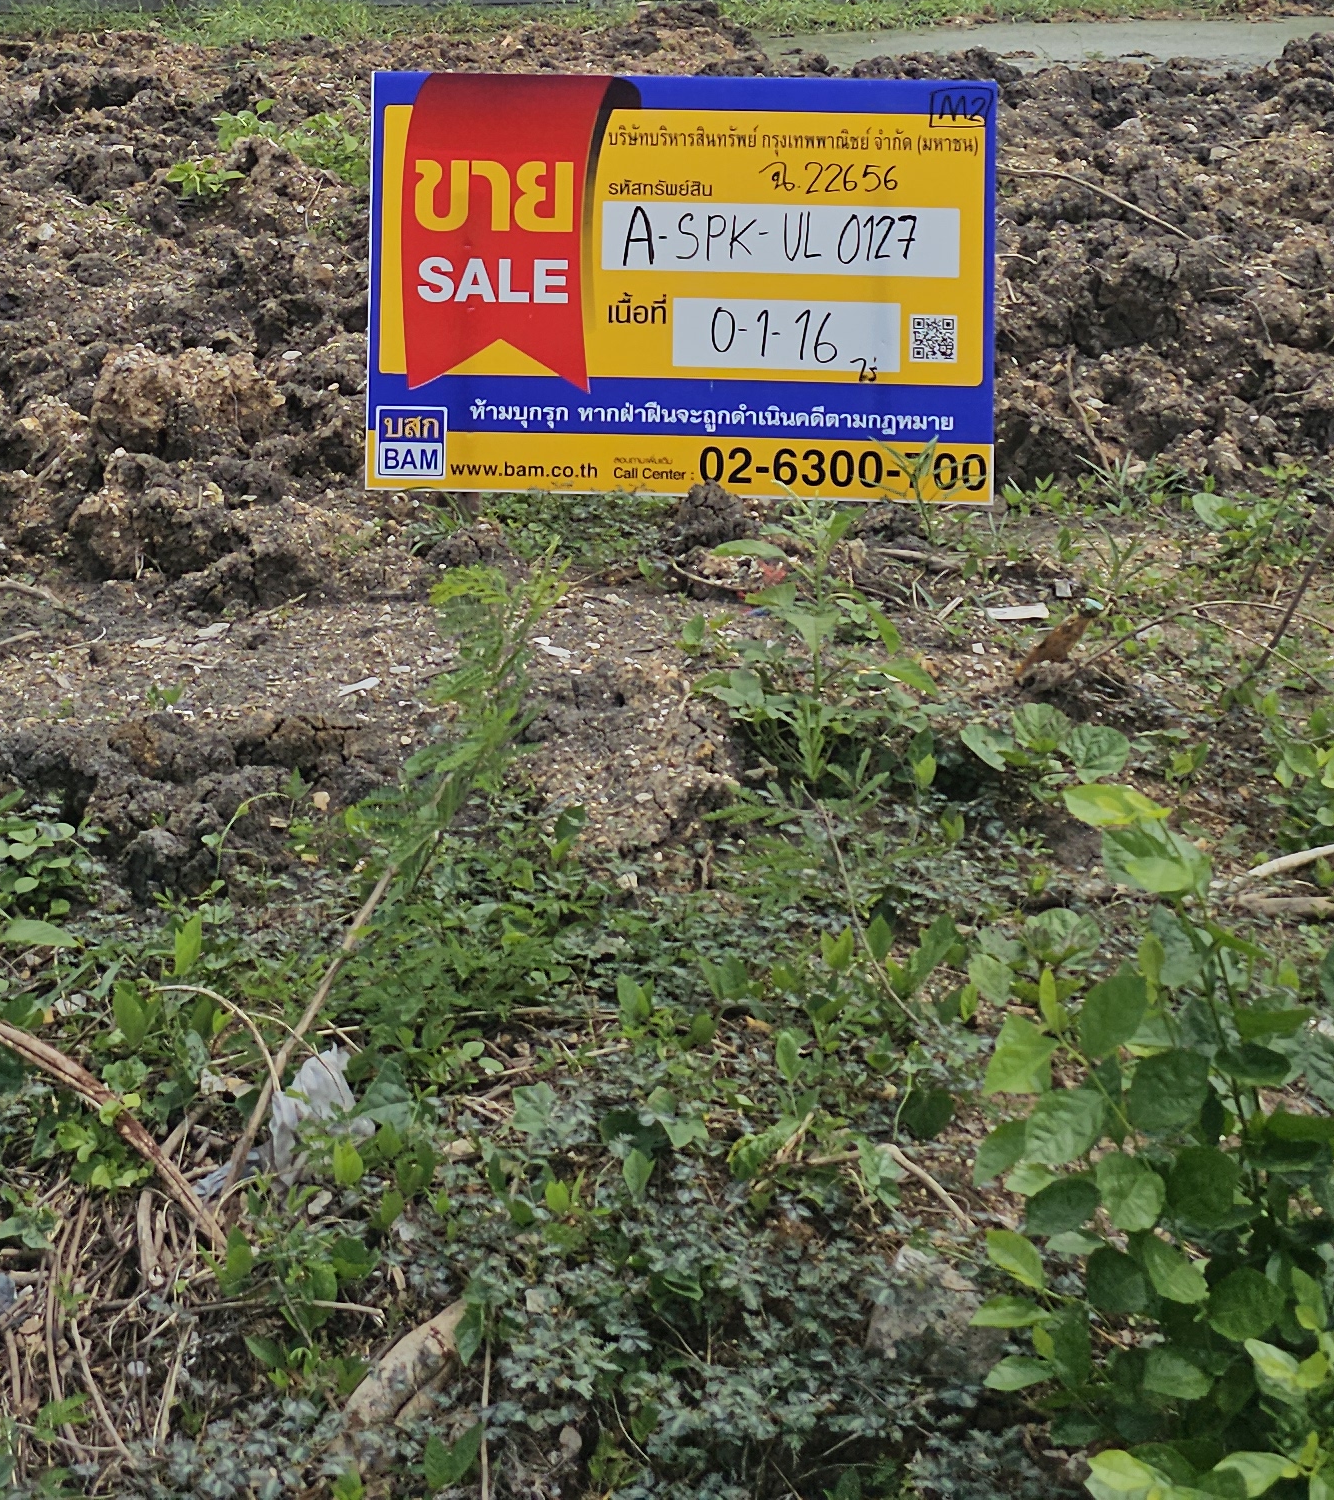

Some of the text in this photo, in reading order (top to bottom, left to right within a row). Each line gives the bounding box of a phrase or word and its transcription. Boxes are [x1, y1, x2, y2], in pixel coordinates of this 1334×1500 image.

[608, 124, 979, 157] บริษัทบริหารสินทรัพย์ กรุงเทพพาณิชย์ จำกัด (มหาชน)
[414, 159, 574, 233] ขาย
[608, 179, 713, 197] รหัสทรัพย์สิน
[417, 256, 569, 304] SALE
[607, 292, 667, 325] เนื้อที่
[383, 415, 440, 439] บสก
[469, 398, 954, 435] ห้ามบุกรุก หากฝ่าฝืนจะถูกดำเนินคดีตามกฎหมาย
[384, 447, 438, 471] BAM
[450, 461, 598, 479] www.bam.co.th
[613, 466, 638, 479] Call
[642, 467, 687, 481] Center
